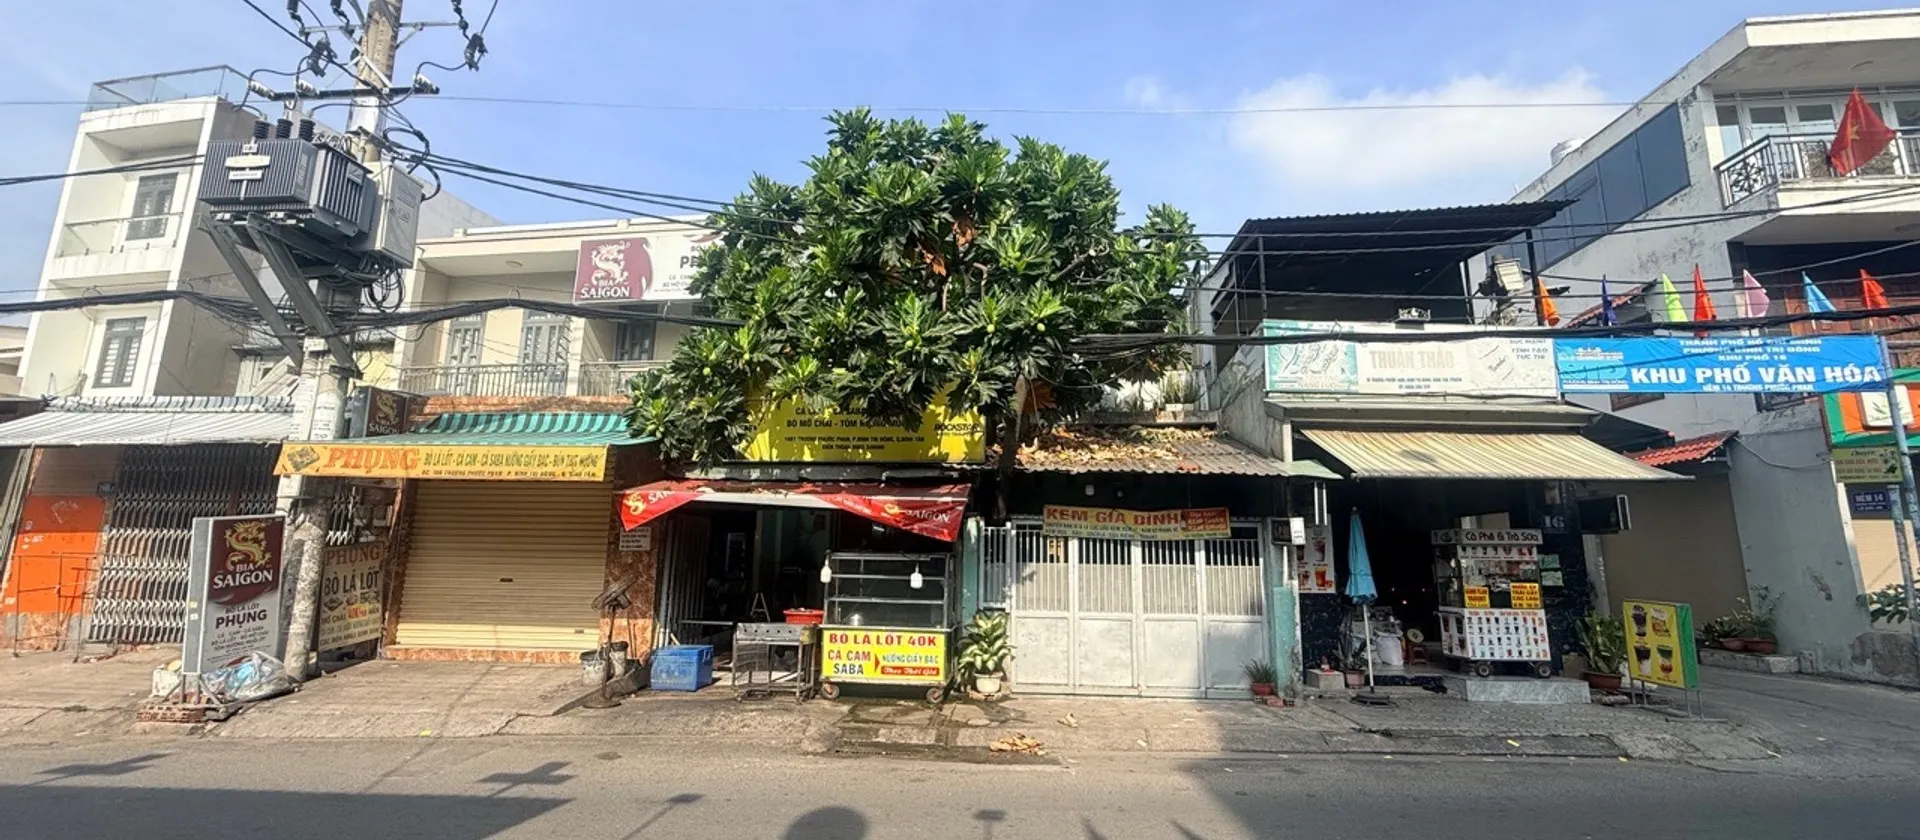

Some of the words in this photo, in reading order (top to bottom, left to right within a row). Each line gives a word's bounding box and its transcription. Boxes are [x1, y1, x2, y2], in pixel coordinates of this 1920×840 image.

[580, 286, 630, 299] SAIGON
[1718, 354, 1743, 362] KHU
[1630, 367, 1688, 384] KHU
[1694, 362, 1752, 384] PHỐ
[1757, 363, 1817, 383] VĂN
[1823, 362, 1883, 383] HÓA
[369, 423, 400, 434] SAIGON
[324, 447, 421, 474] PHỤNG
[1874, 493, 1884, 501] 14
[904, 506, 952, 524] SAIGON
[1047, 508, 1089, 522] KEM
[325, 545, 381, 566] PHỤNG
[236, 563, 255, 572] BIA
[213, 569, 273, 589] SAIGON
[323, 572, 340, 596] BÒ
[343, 568, 357, 594] LÁ
[360, 566, 380, 590] LỐT
[215, 609, 268, 629] PHỤNG
[907, 636, 937, 646] 40K
[827, 647, 842, 661] CÁ
[846, 651, 871, 662] CAM
[833, 662, 864, 675] SABA
